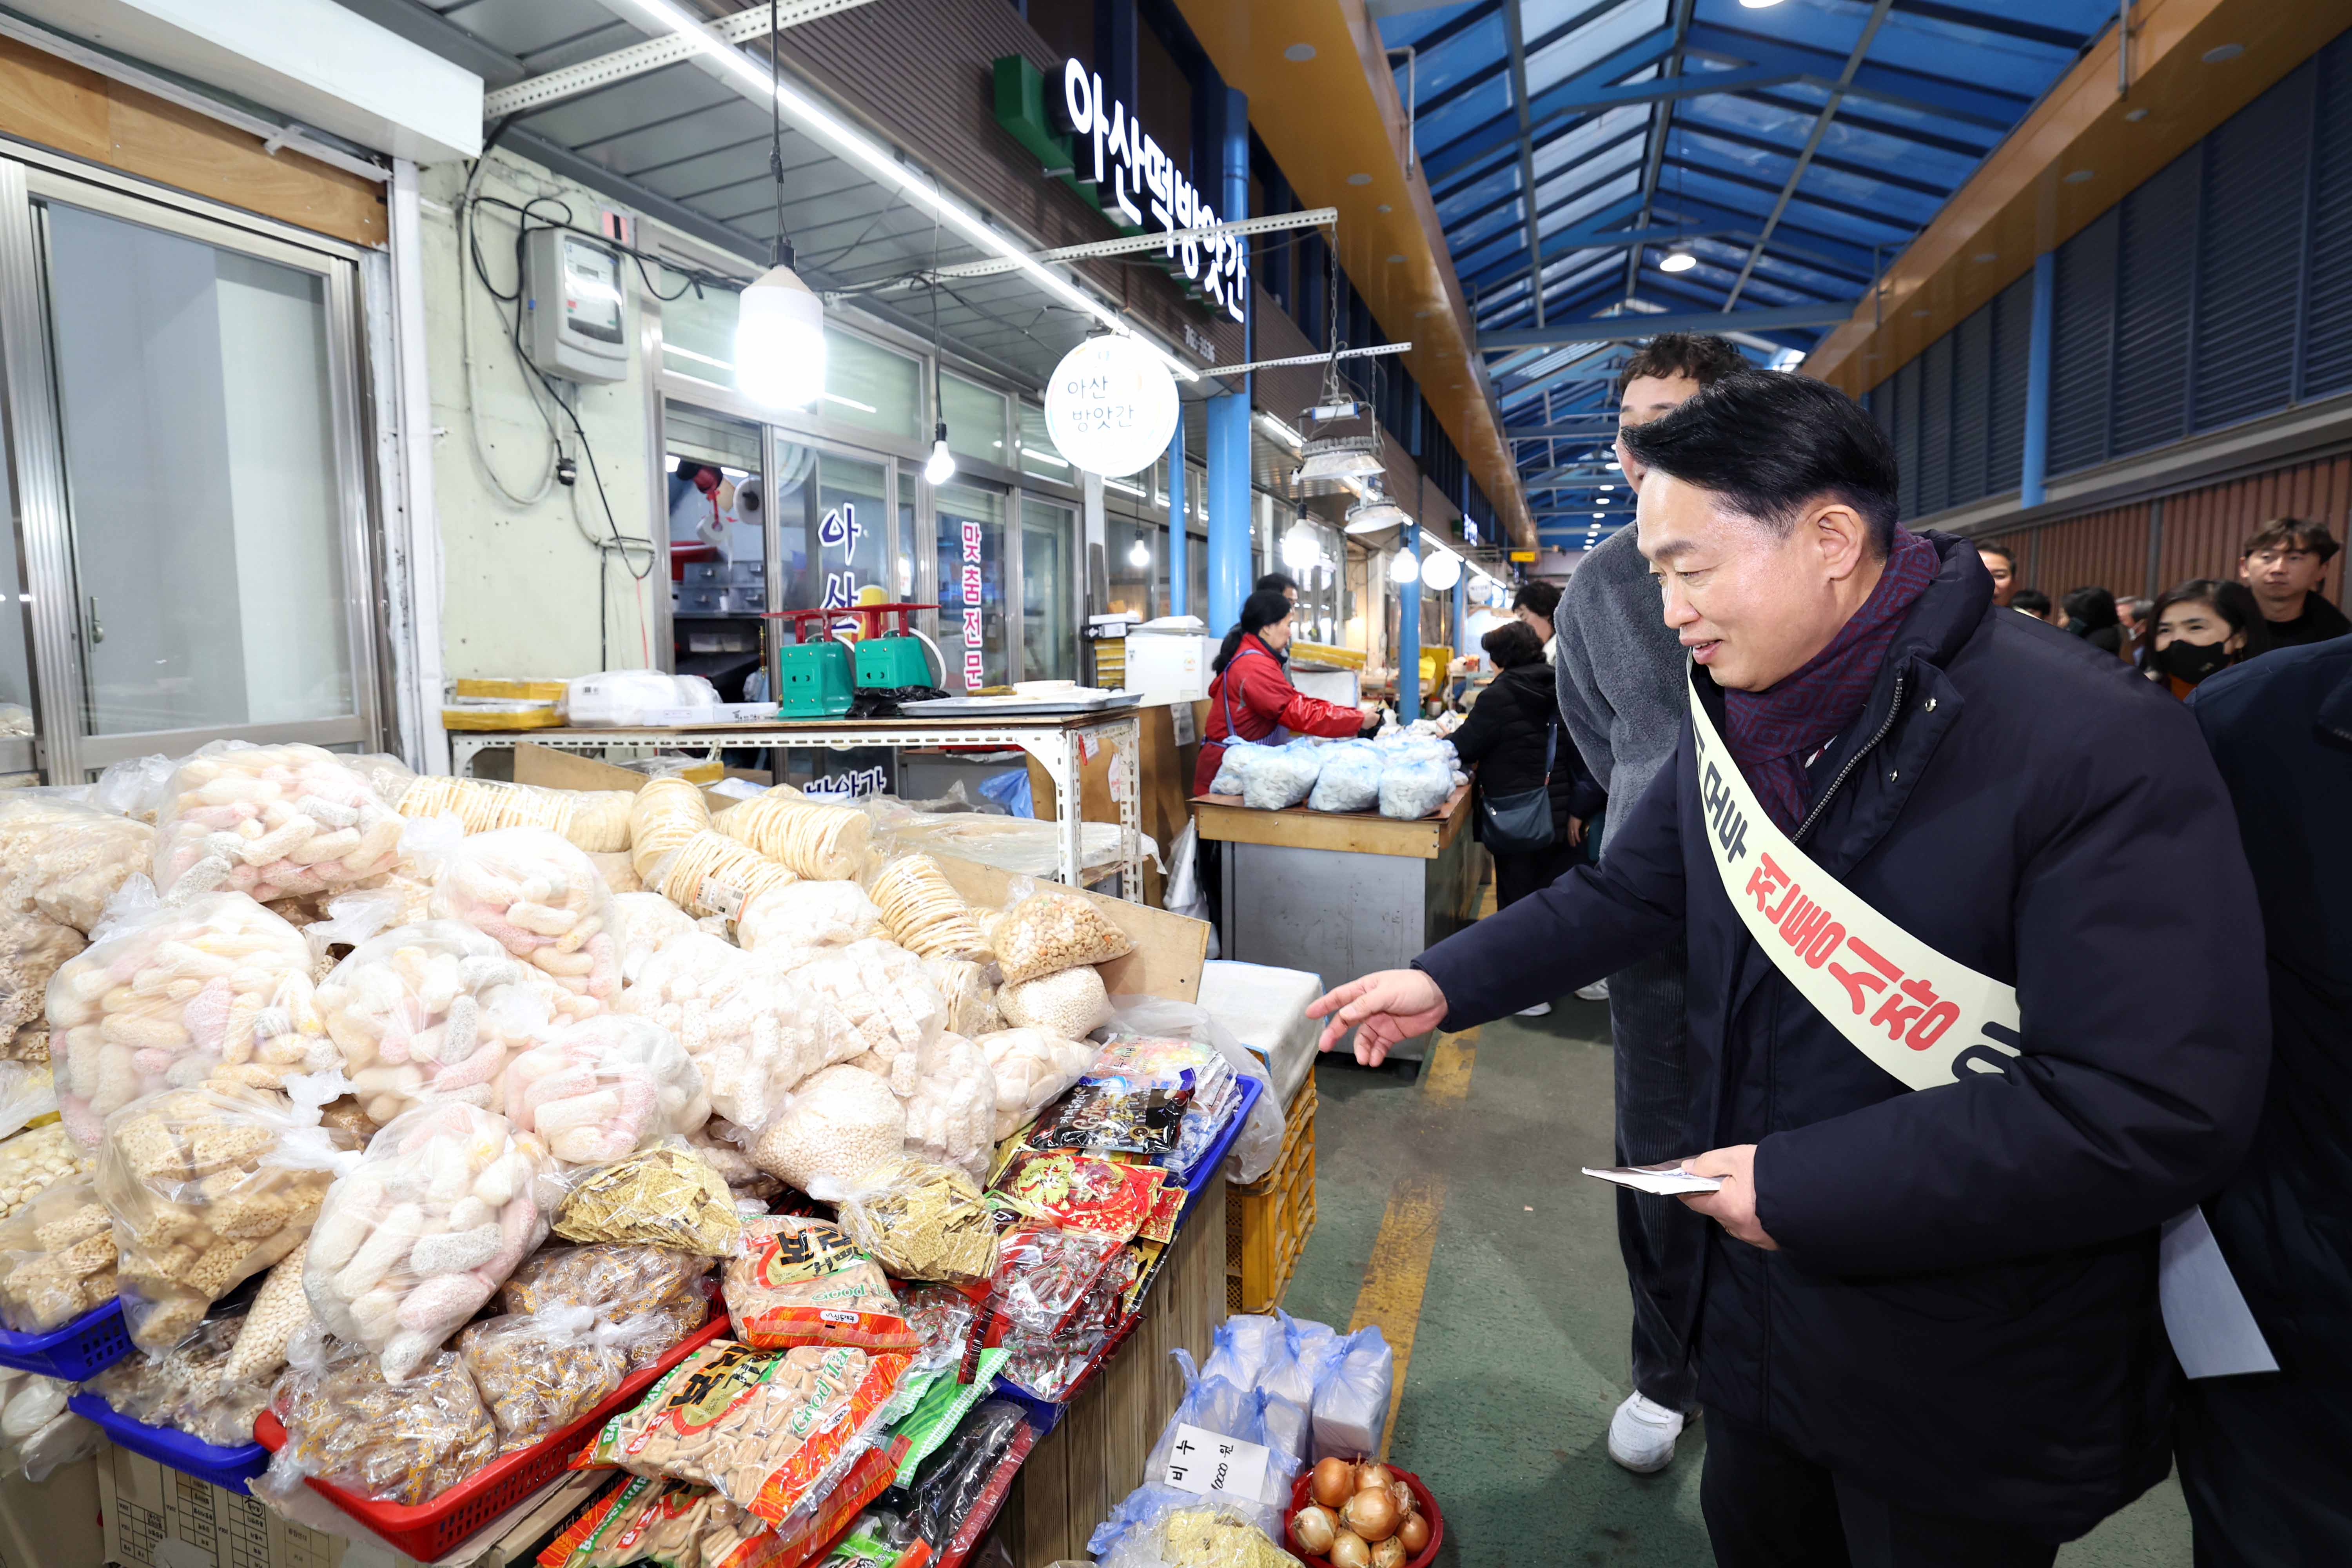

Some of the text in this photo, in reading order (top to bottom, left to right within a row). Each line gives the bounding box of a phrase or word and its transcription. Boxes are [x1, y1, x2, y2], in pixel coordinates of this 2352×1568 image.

[1073, 405, 1134, 432] 방앗간
[1746, 851, 1960, 1051] 전통시장
[812, 1284, 866, 1301] Good
[791, 1377, 833, 1434] Good
[1220, 1445, 1234, 1458] 원
